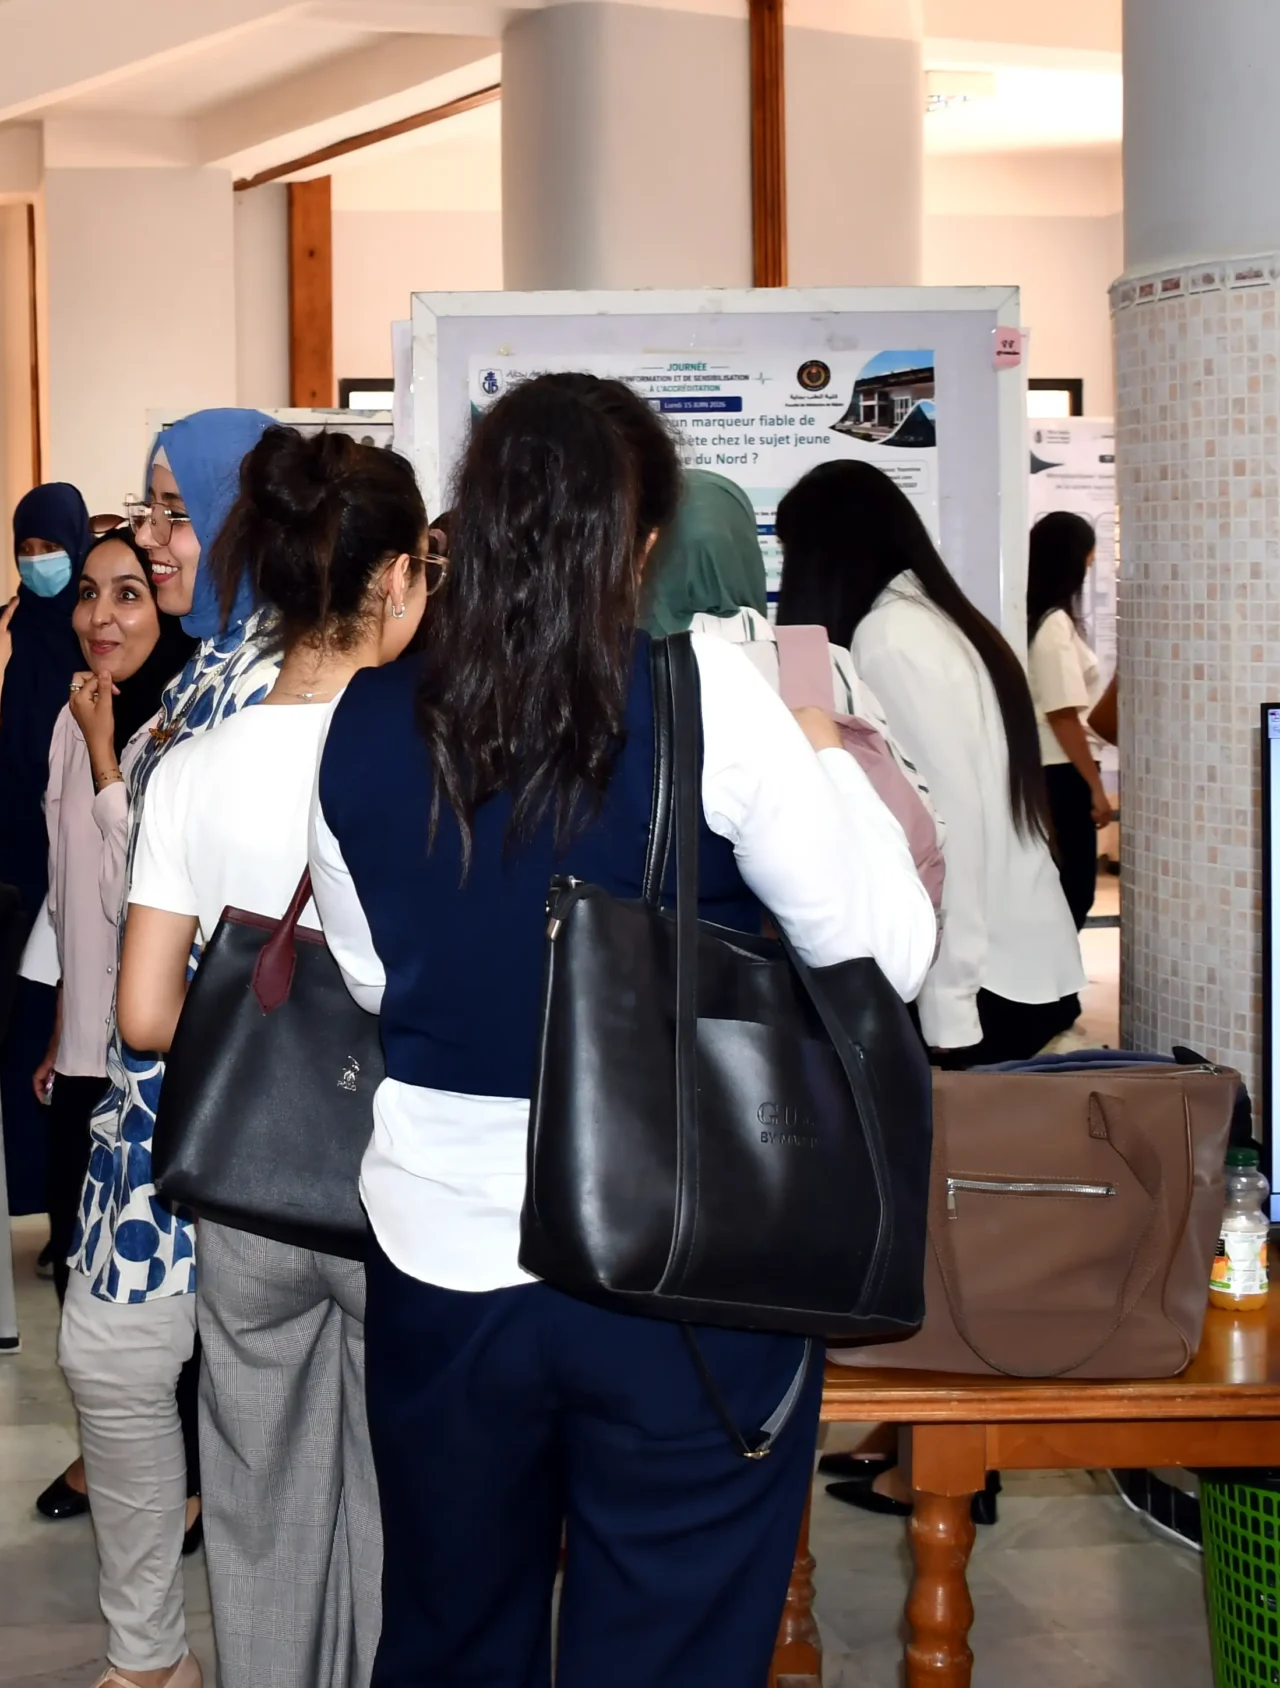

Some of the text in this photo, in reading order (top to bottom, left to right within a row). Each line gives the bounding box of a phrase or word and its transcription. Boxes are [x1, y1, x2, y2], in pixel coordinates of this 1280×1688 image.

[666, 361, 707, 371] JOURNÉE
[693, 373, 750, 381] SENSIBILISATION
[692, 418, 755, 430] marqueur
[759, 414, 795, 426] fiable
[799, 414, 816, 426] de
[712, 434, 740, 446] chez
[743, 434, 756, 445] le
[759, 433, 791, 448] sujet
[793, 433, 831, 447] jeune
[695, 453, 712, 465] du
[716, 452, 748, 465] Nord
[751, 452, 759, 464] ?
